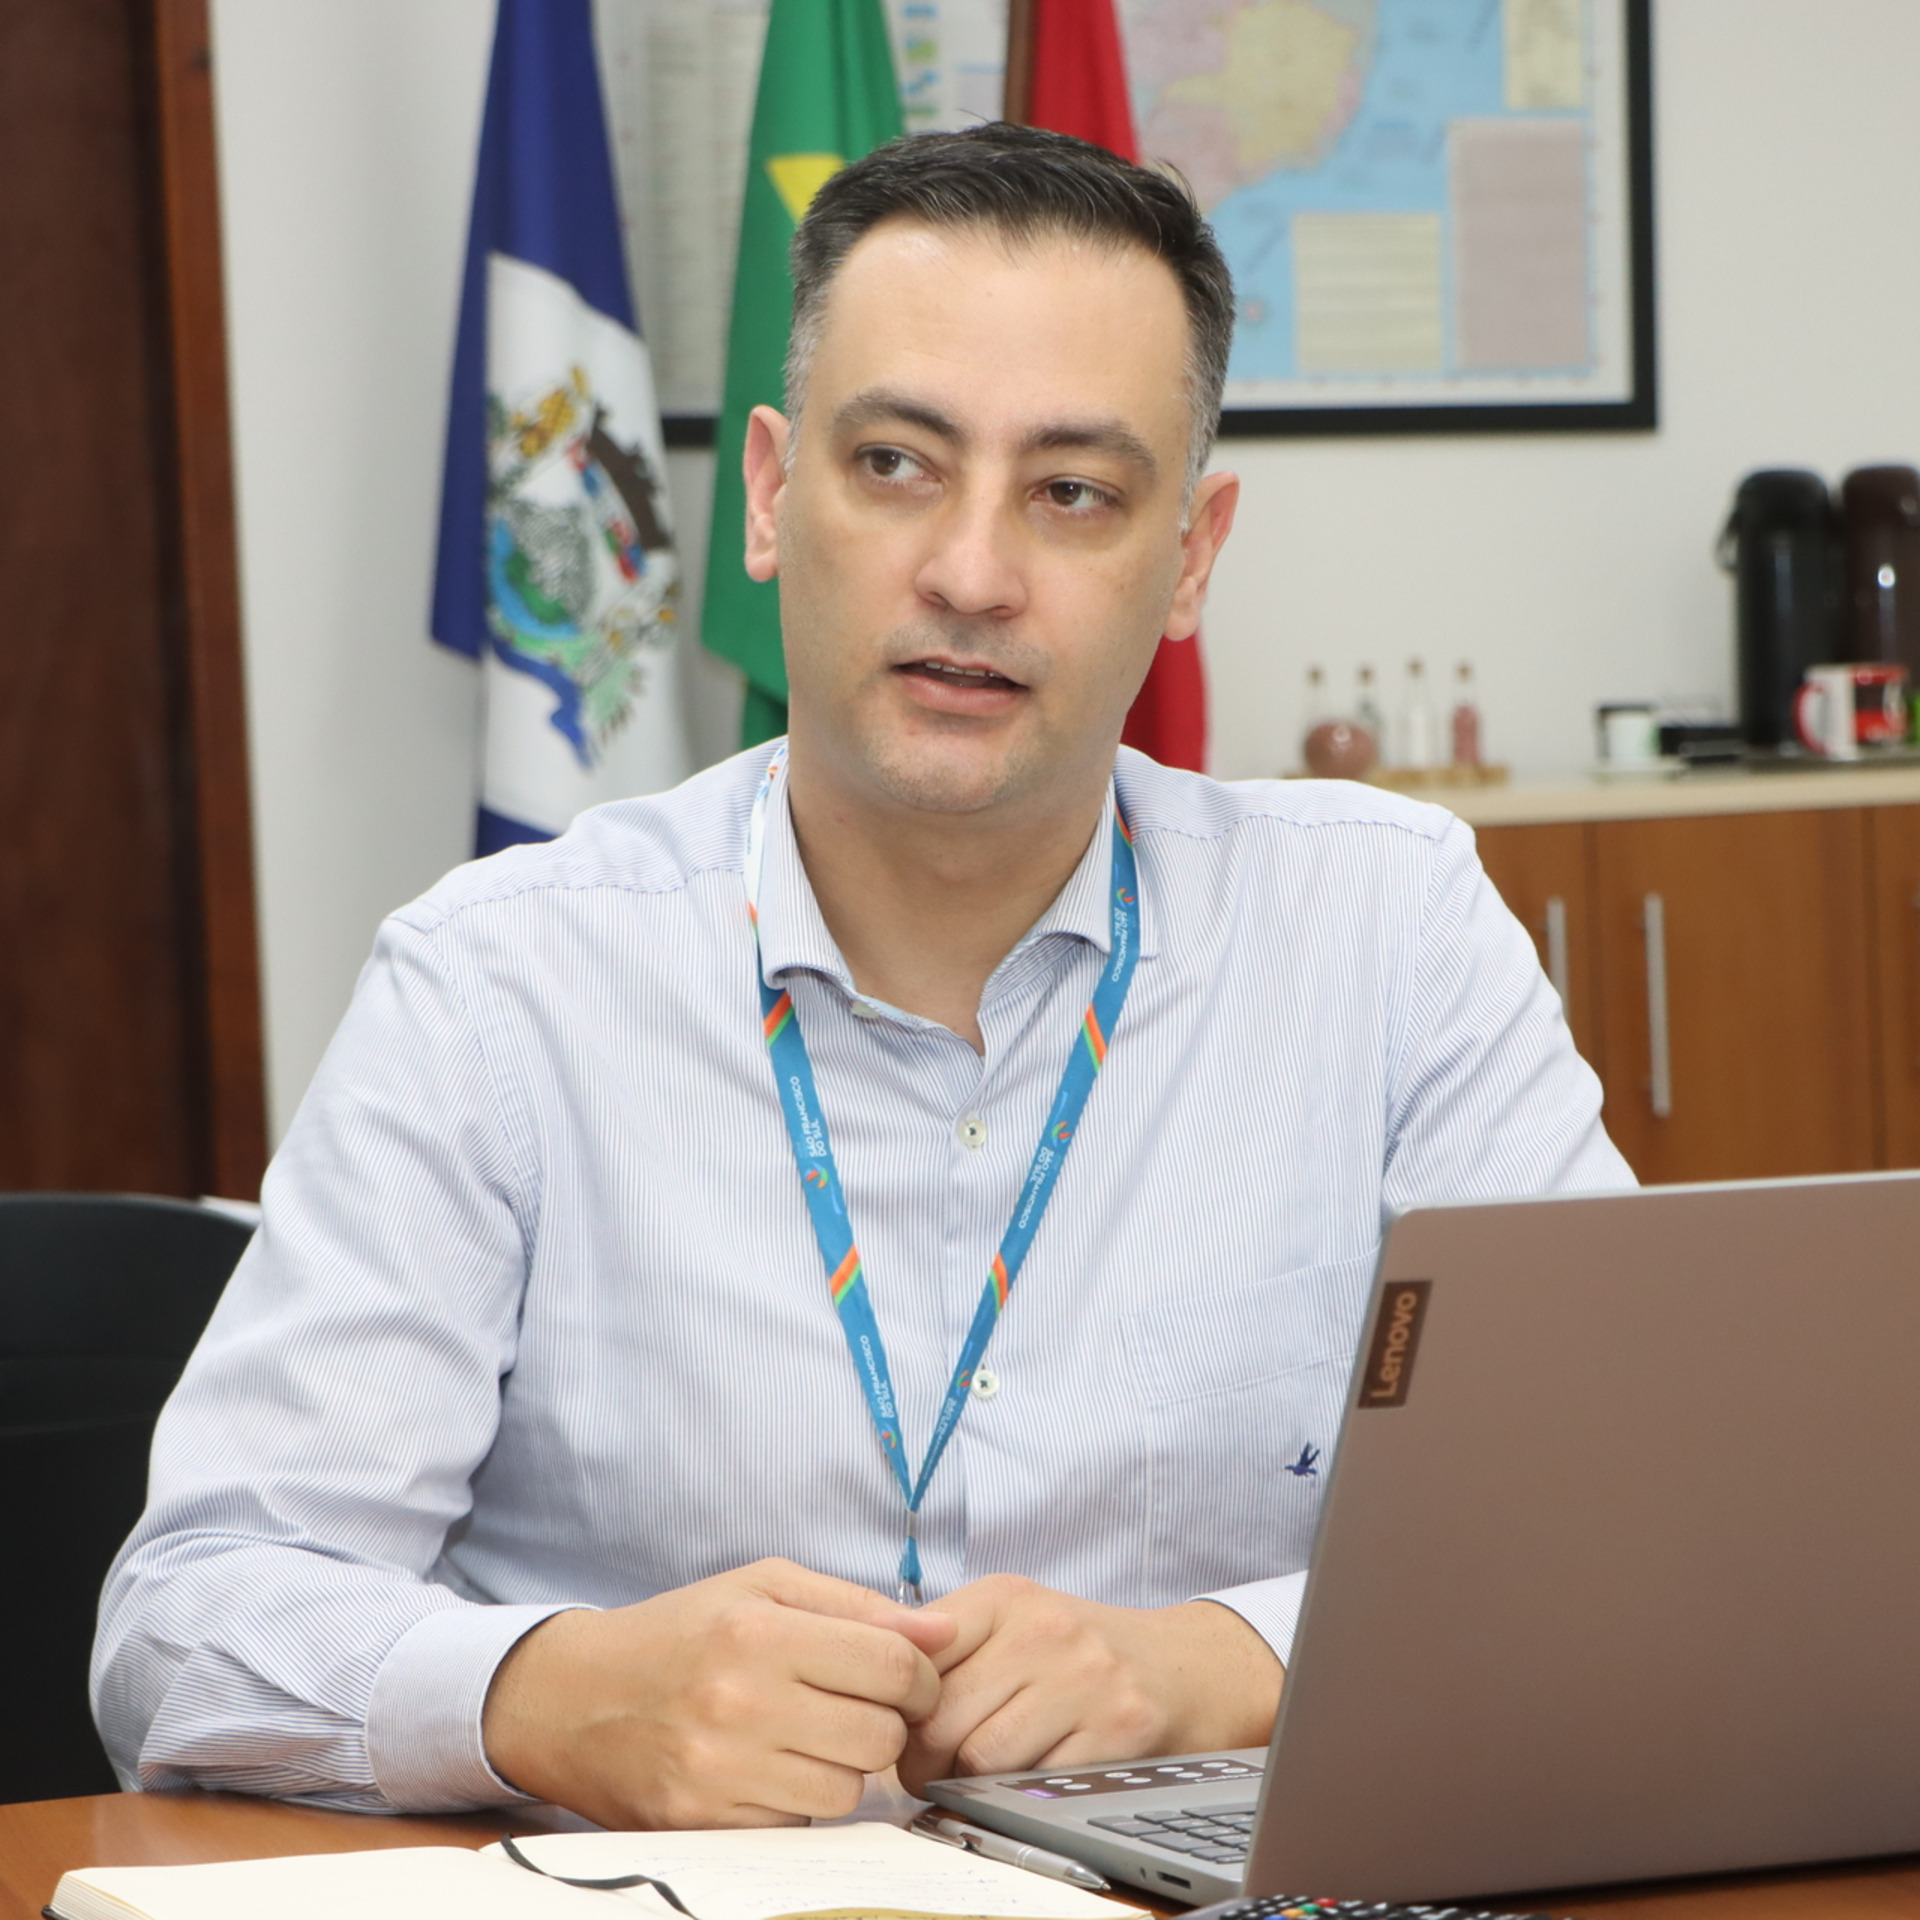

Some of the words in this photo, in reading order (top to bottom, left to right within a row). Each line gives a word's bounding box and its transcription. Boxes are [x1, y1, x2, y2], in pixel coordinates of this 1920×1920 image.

[1112, 929, 1128, 982] FRANCISCO
[790, 1076, 810, 1134] FRANCISCO
[810, 1118, 822, 1138] SUL
[816, 1140, 826, 1156] DO
[1030, 1164, 1042, 1182] SUL
[1038, 1146, 1048, 1162] DO
[1018, 1172, 1046, 1228] FRANCISCO
[860, 1335, 881, 1395] FRANCISCO
[1371, 1291, 1417, 1398] Lenovo
